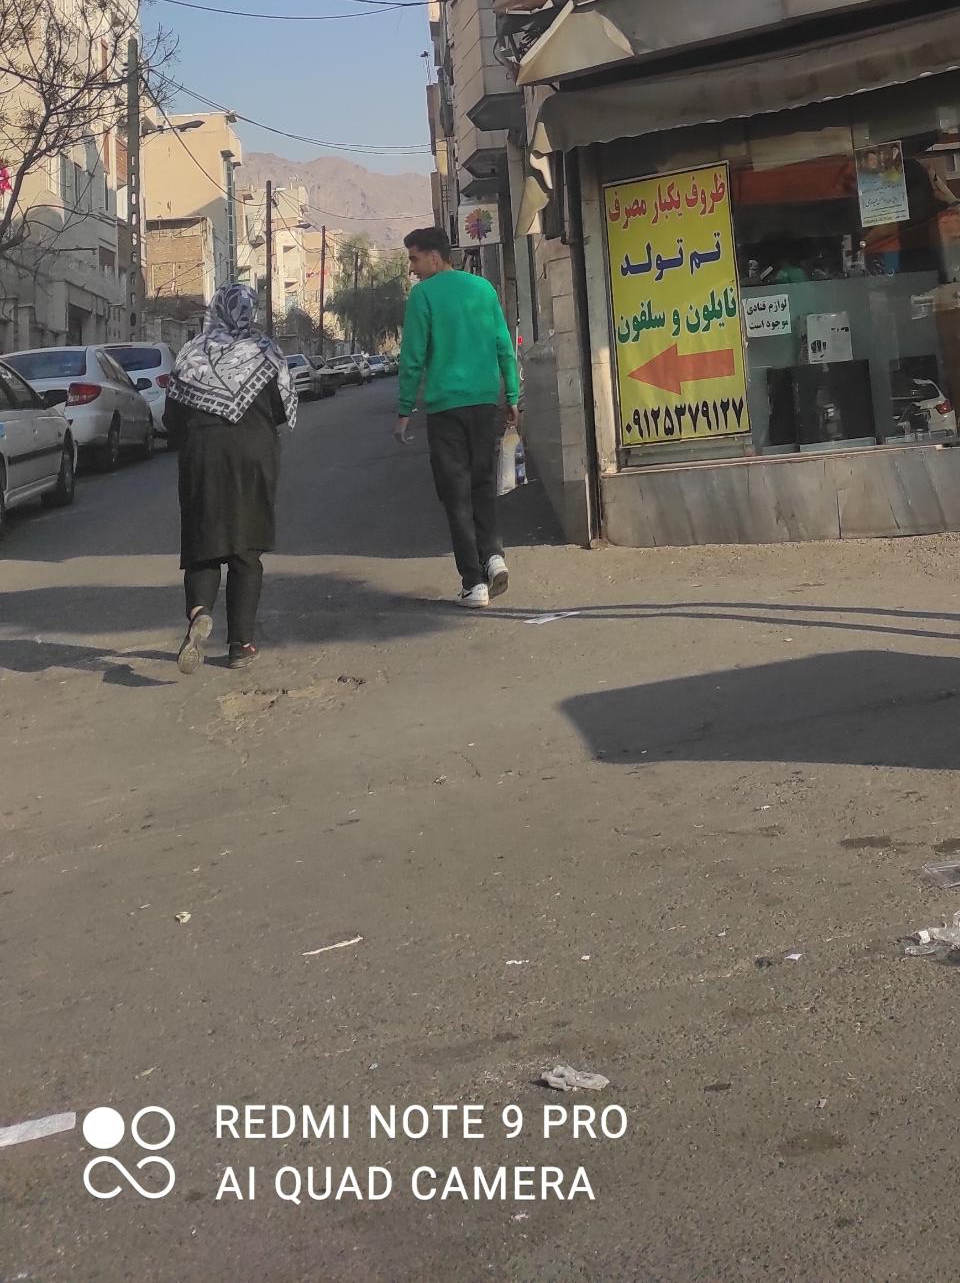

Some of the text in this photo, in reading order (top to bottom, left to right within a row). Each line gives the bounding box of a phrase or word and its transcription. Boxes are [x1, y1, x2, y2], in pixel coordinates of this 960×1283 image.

[608, 172, 726, 229] ظروف یکبار مصرف
[617, 285, 738, 344] نایلون و سلفون
[746, 298, 788, 315] لوازم قنادی
[748, 319, 789, 330] موجود است
[625, 396, 744, 441] ۰۹۱۲۵۳۷۹۱۲۷
